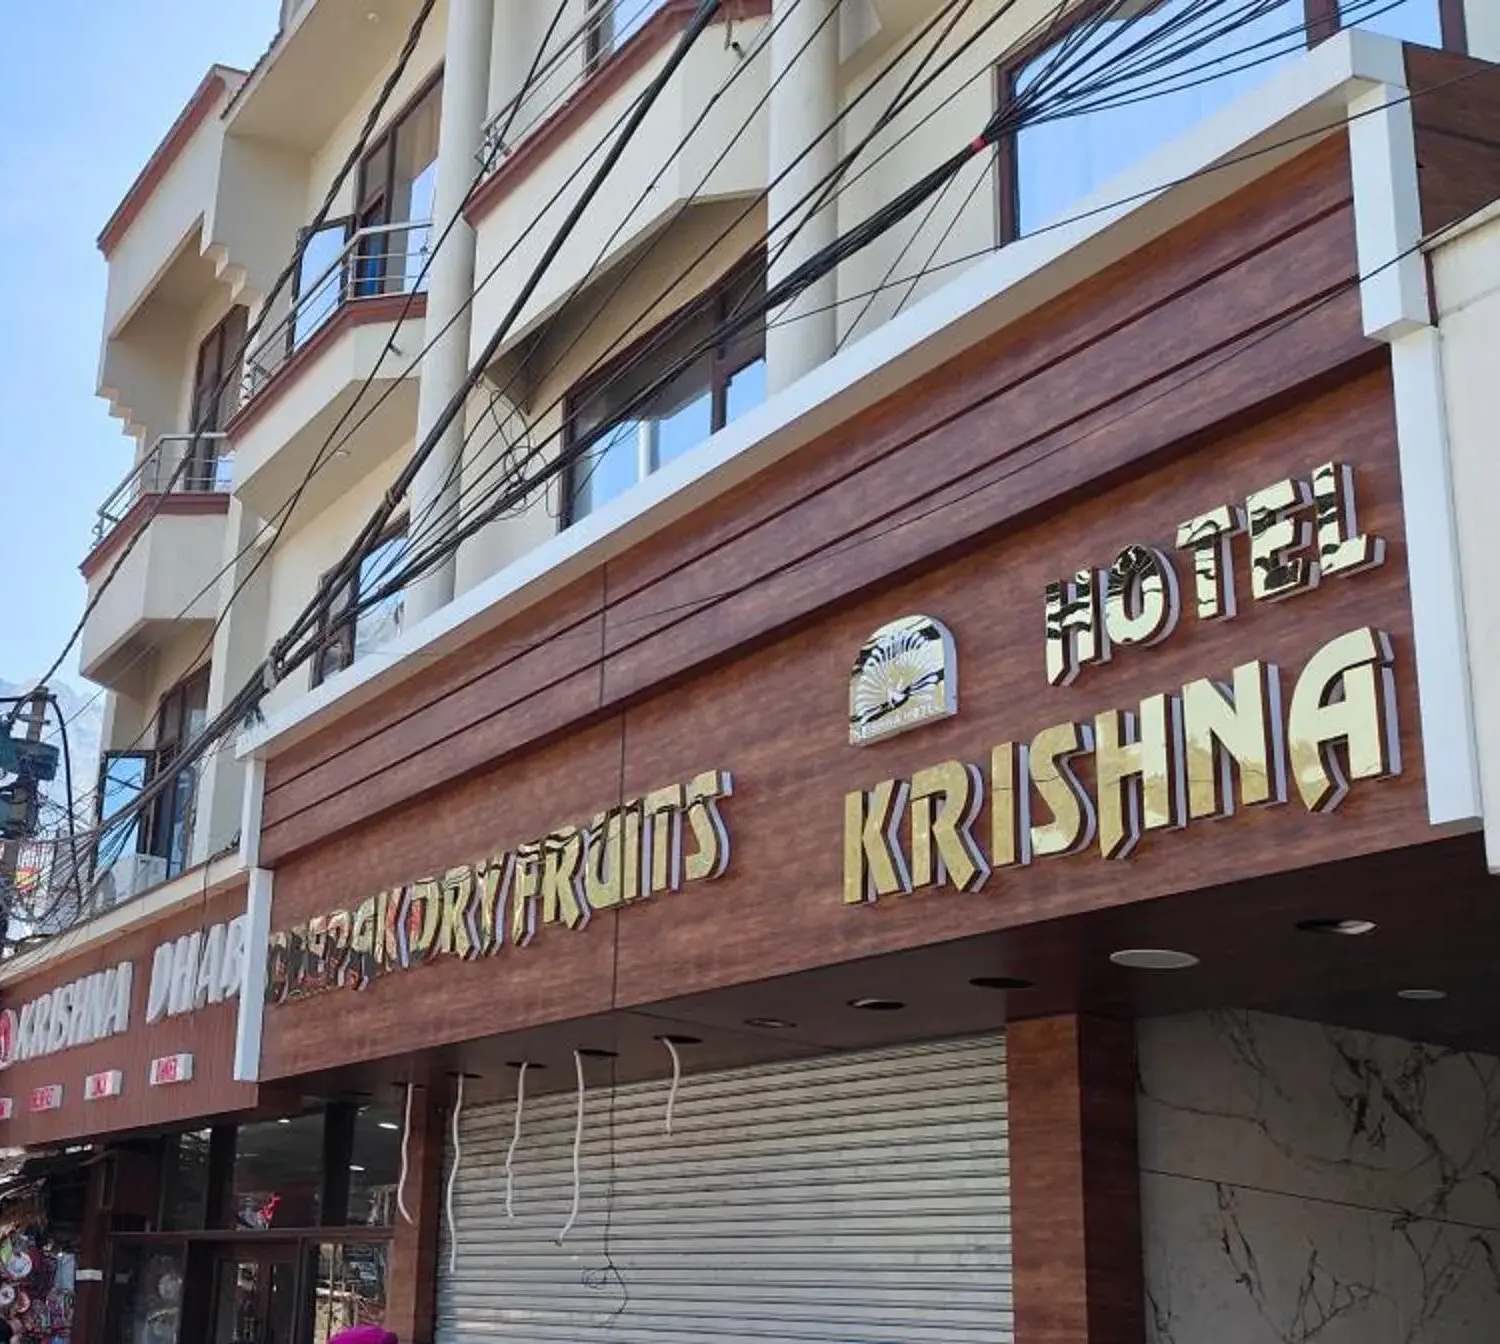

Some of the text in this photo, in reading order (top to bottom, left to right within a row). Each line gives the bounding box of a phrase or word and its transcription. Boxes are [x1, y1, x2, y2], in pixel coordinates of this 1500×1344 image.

[1044, 461, 1386, 687] HOTEL
[511, 769, 734, 947] FRUITS
[843, 626, 1402, 905] KRISHNA
[12, 912, 249, 1062] KRISHNA DHAB
